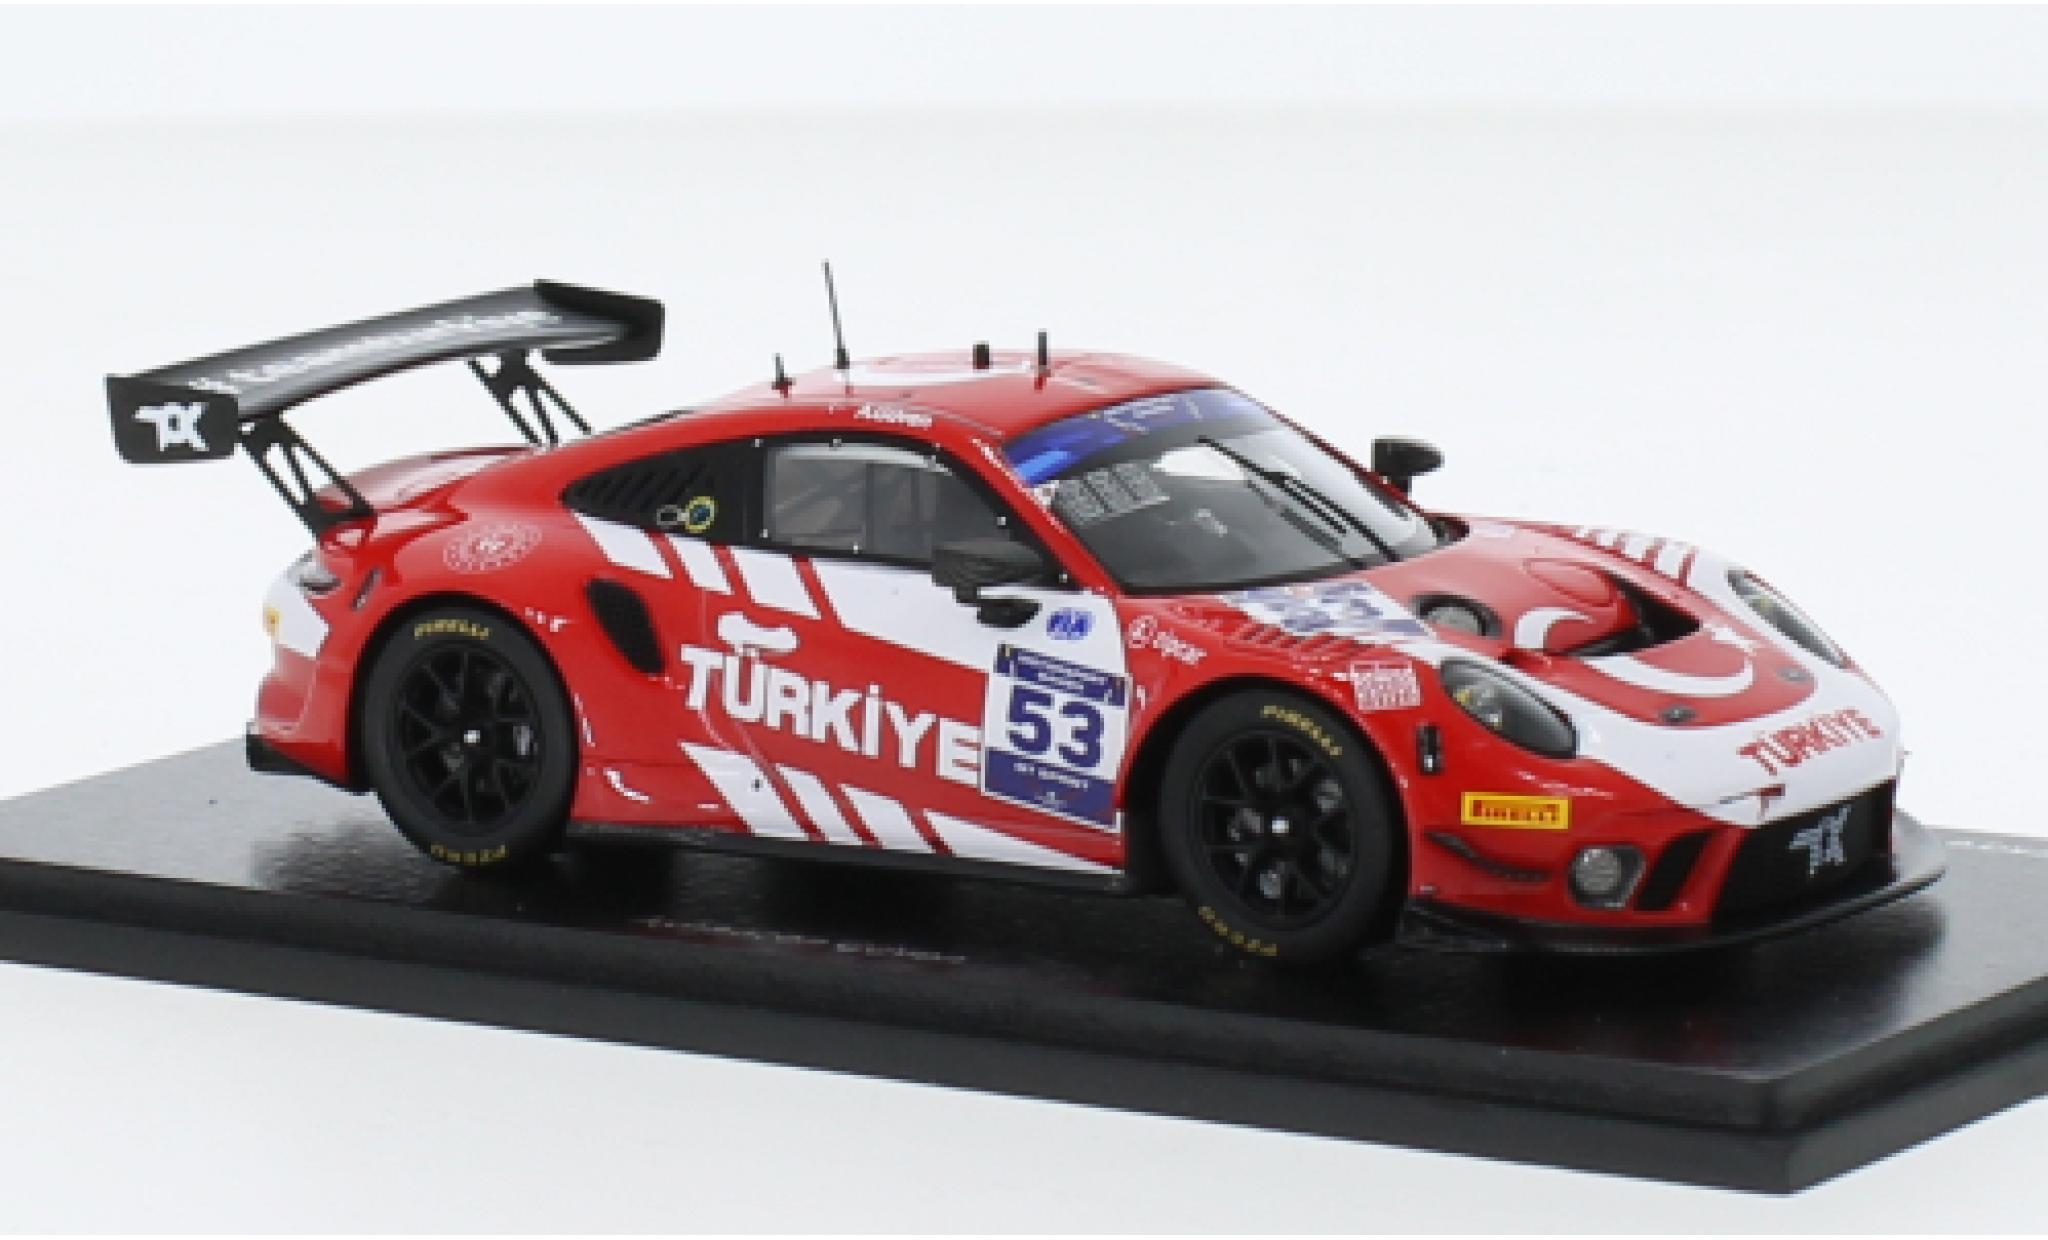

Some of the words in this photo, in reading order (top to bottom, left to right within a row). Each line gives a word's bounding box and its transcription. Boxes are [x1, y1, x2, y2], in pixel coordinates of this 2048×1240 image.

[1047, 611, 1093, 639] FIA
[681, 643, 981, 788] TÜRKİYE
[1009, 686, 1105, 769] 53
[1736, 705, 1882, 776] TÜRKİYE
[1472, 799, 1561, 823] PIRELLI
